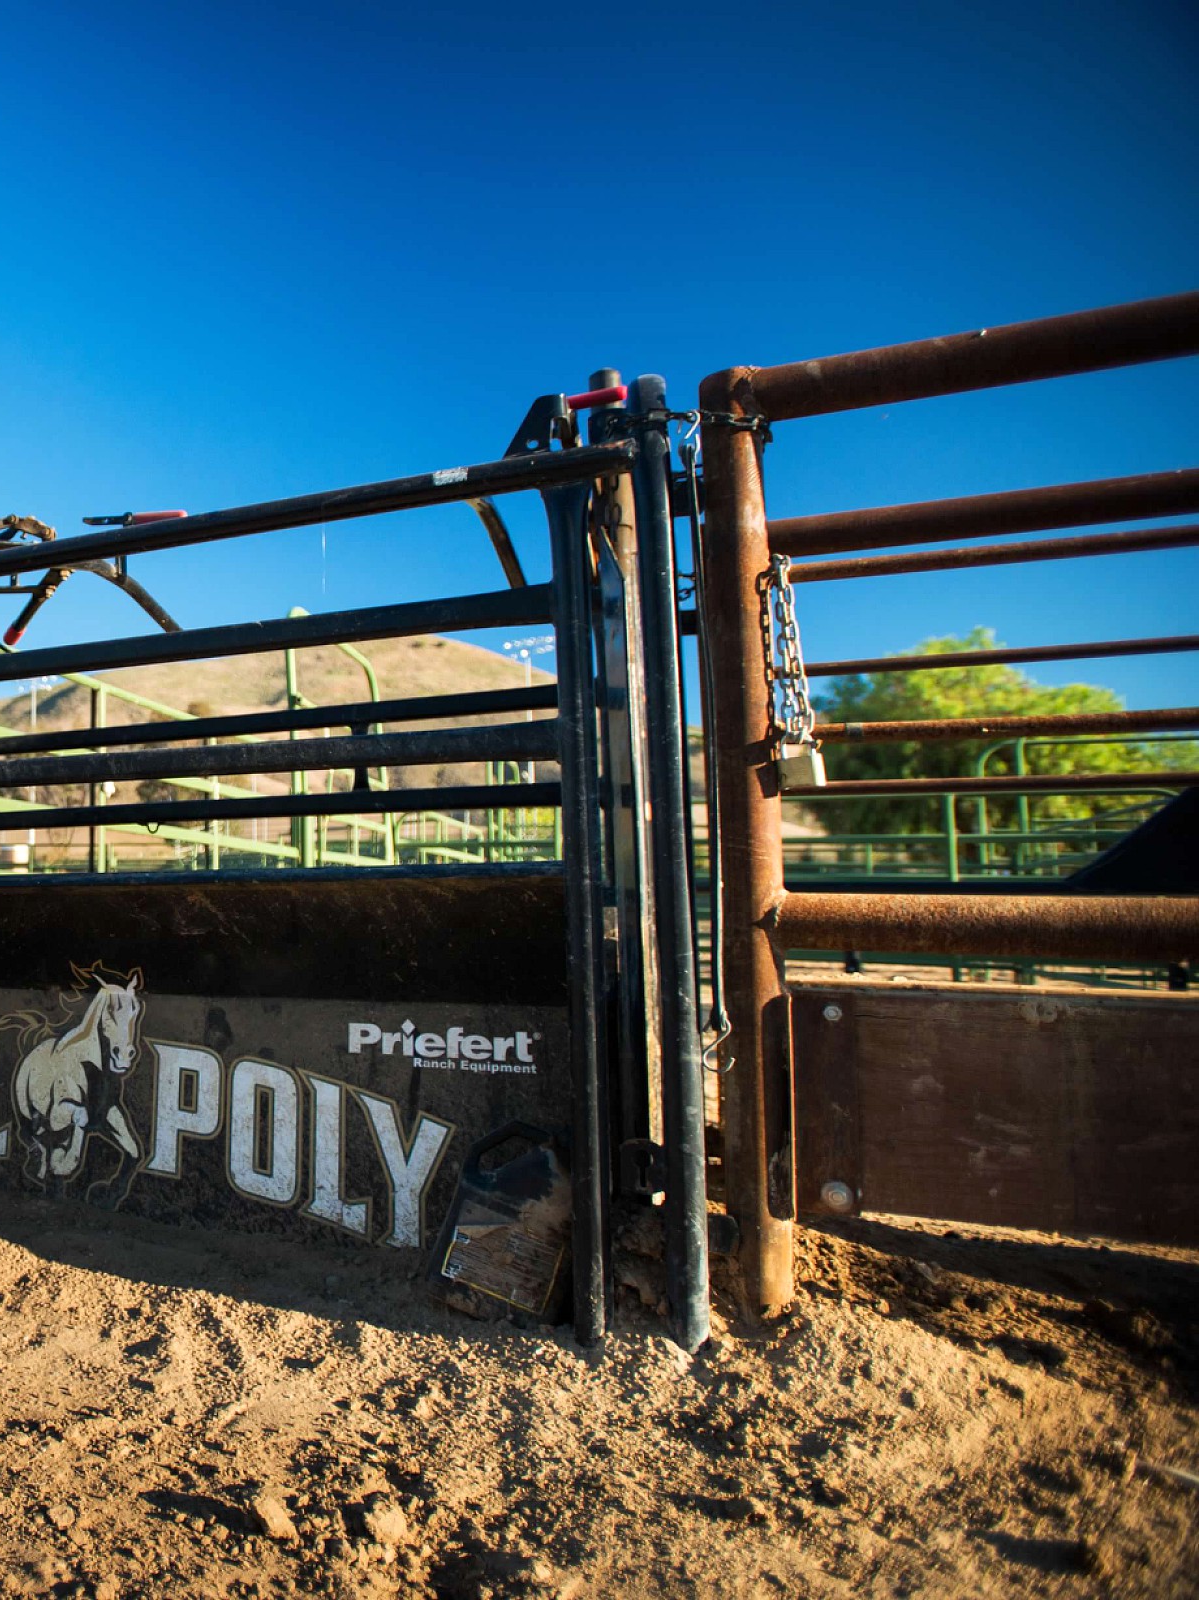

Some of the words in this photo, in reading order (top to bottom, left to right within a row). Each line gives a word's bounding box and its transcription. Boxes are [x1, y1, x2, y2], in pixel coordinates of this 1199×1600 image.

[348, 1018, 534, 1063] Priefert
[413, 1057, 455, 1069] Ranch
[460, 1060, 537, 1075] Equipment
[142, 1037, 456, 1248] POLY
